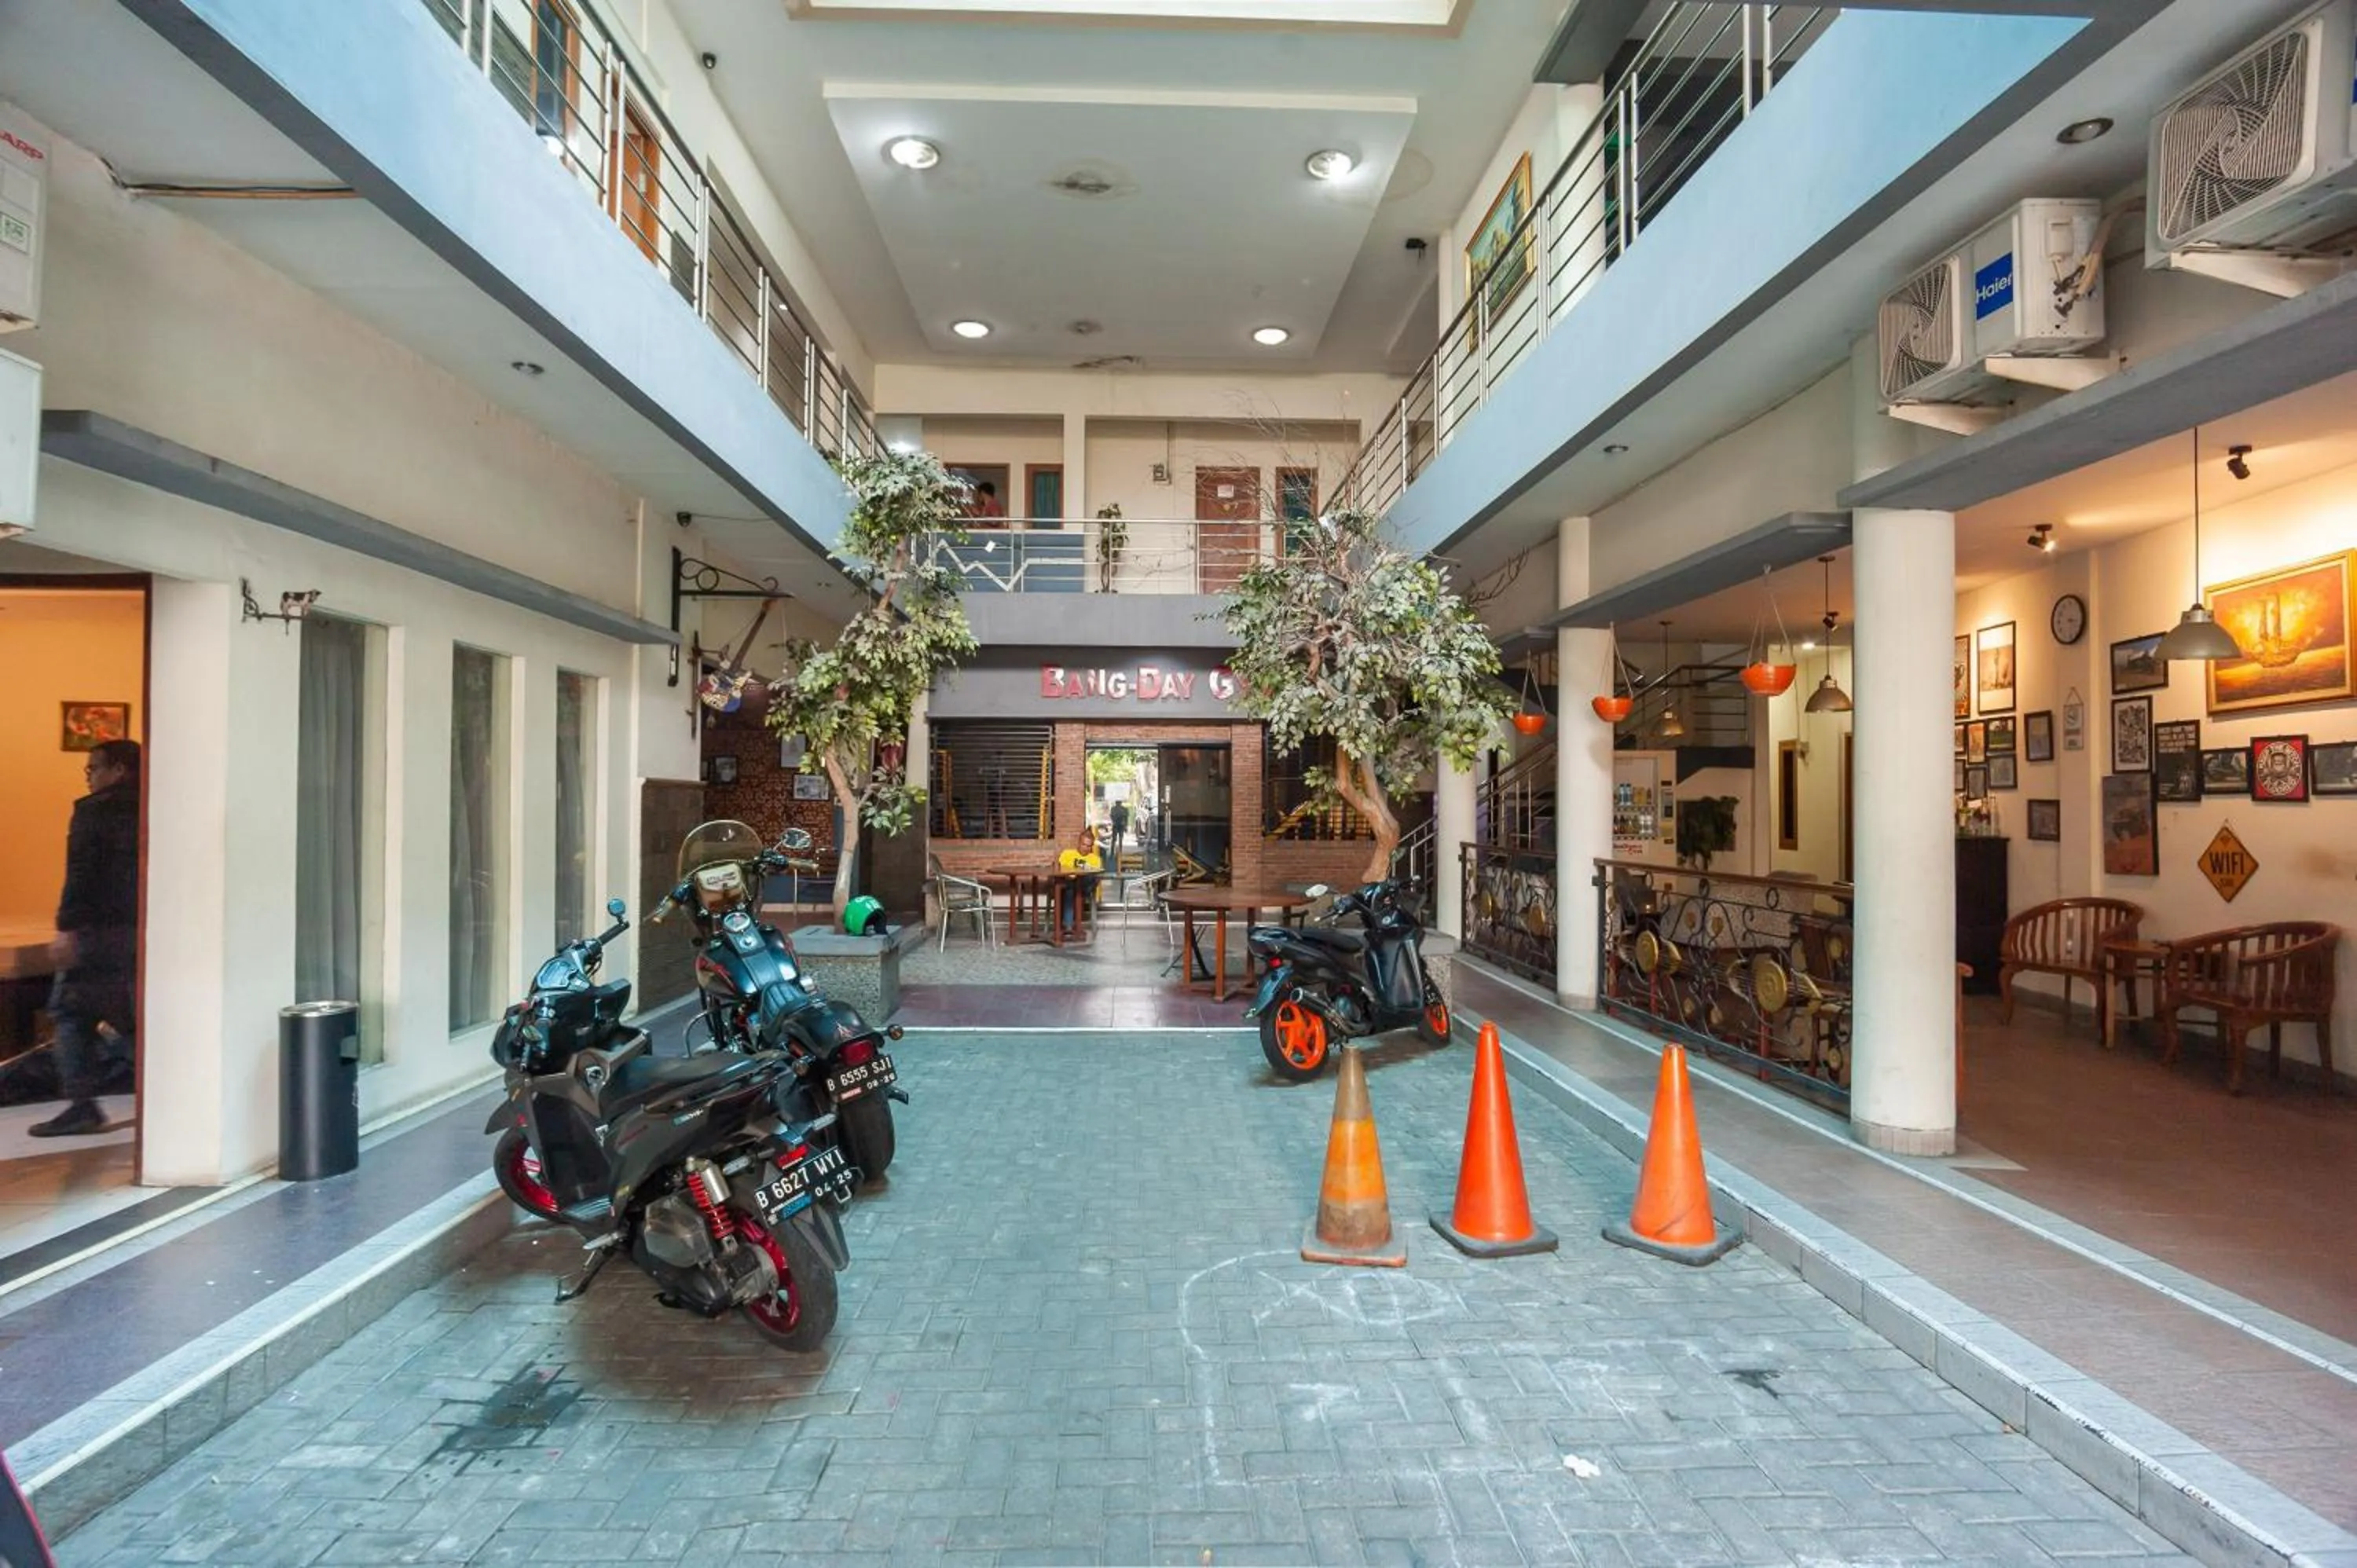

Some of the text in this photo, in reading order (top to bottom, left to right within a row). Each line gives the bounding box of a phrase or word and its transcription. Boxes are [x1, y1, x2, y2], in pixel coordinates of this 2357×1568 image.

[1975, 272, 2013, 305] Haier
[2209, 851, 2245, 875] WIFI
[827, 1079, 835, 1091] B
[840, 1066, 868, 1086] 6555
[755, 1191, 769, 1208] B
[771, 1167, 811, 1200] 6627
[813, 1149, 845, 1176] WYI
